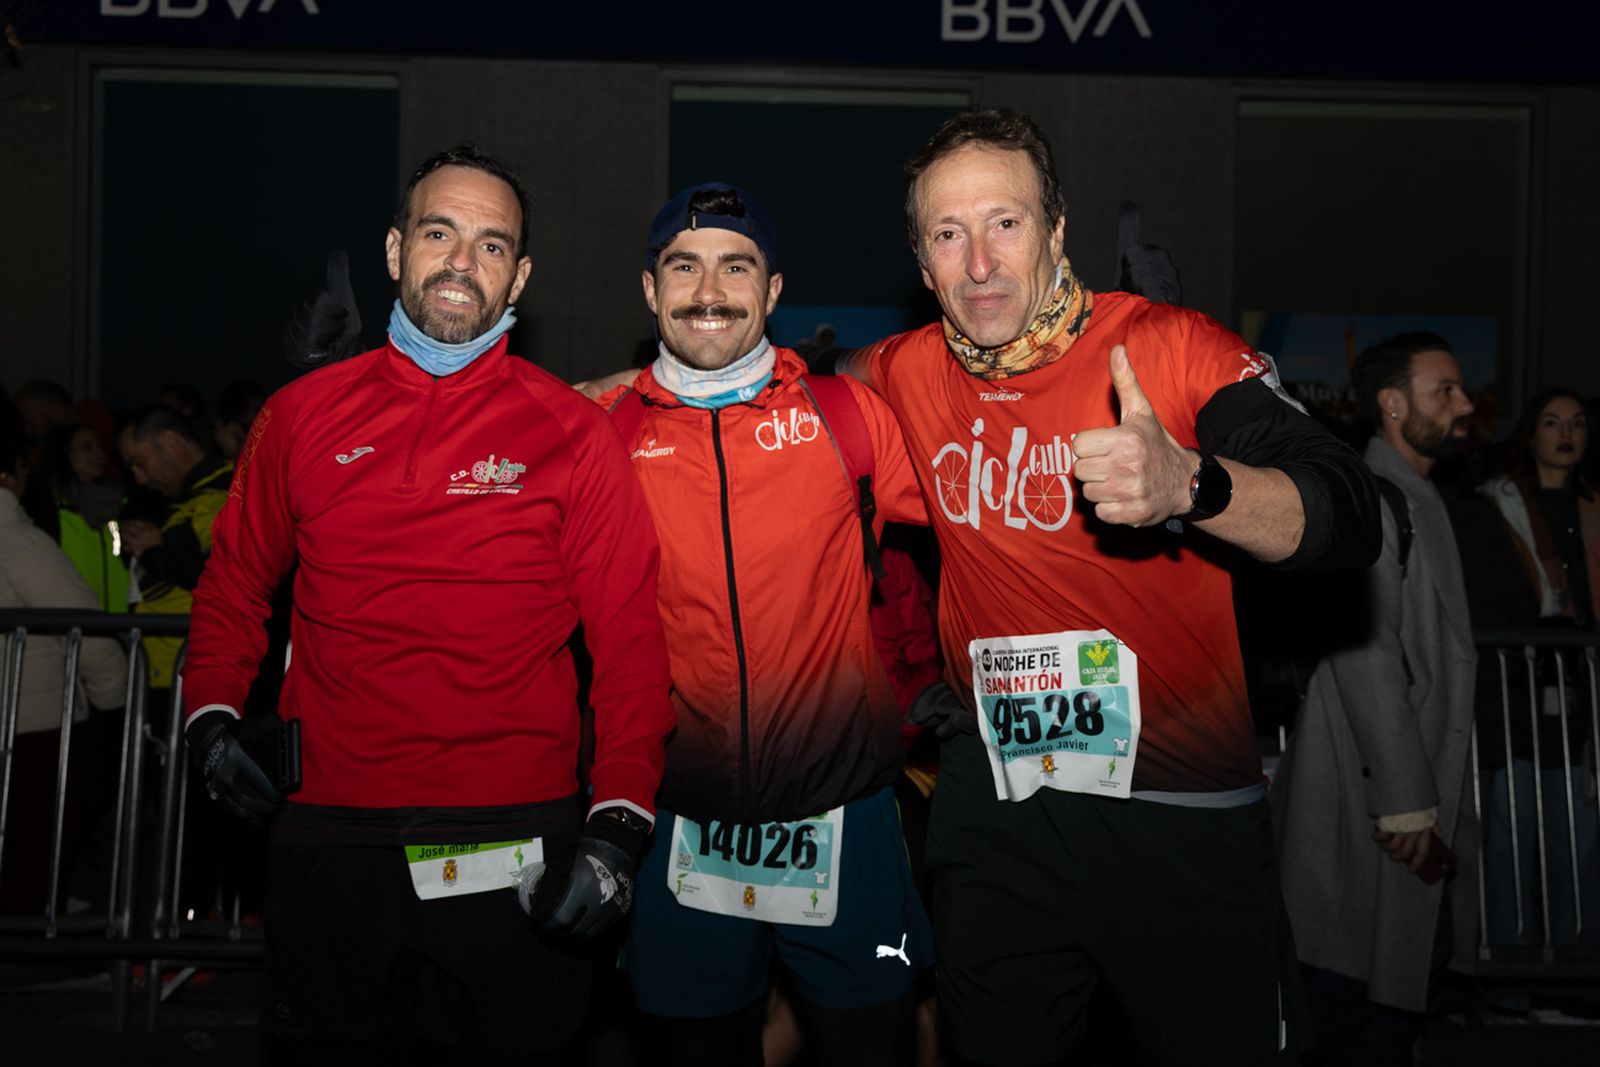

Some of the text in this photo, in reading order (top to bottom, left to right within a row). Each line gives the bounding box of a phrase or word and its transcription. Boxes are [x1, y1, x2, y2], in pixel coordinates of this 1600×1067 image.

[940, 0, 1153, 44] BBVA
[994, 652, 1061, 672] NOCHE DE
[993, 691, 1104, 745] 9528
[1000, 738, 1089, 760] Francisco Javier
[417, 845, 445, 859] José
[699, 816, 818, 870] 14026
